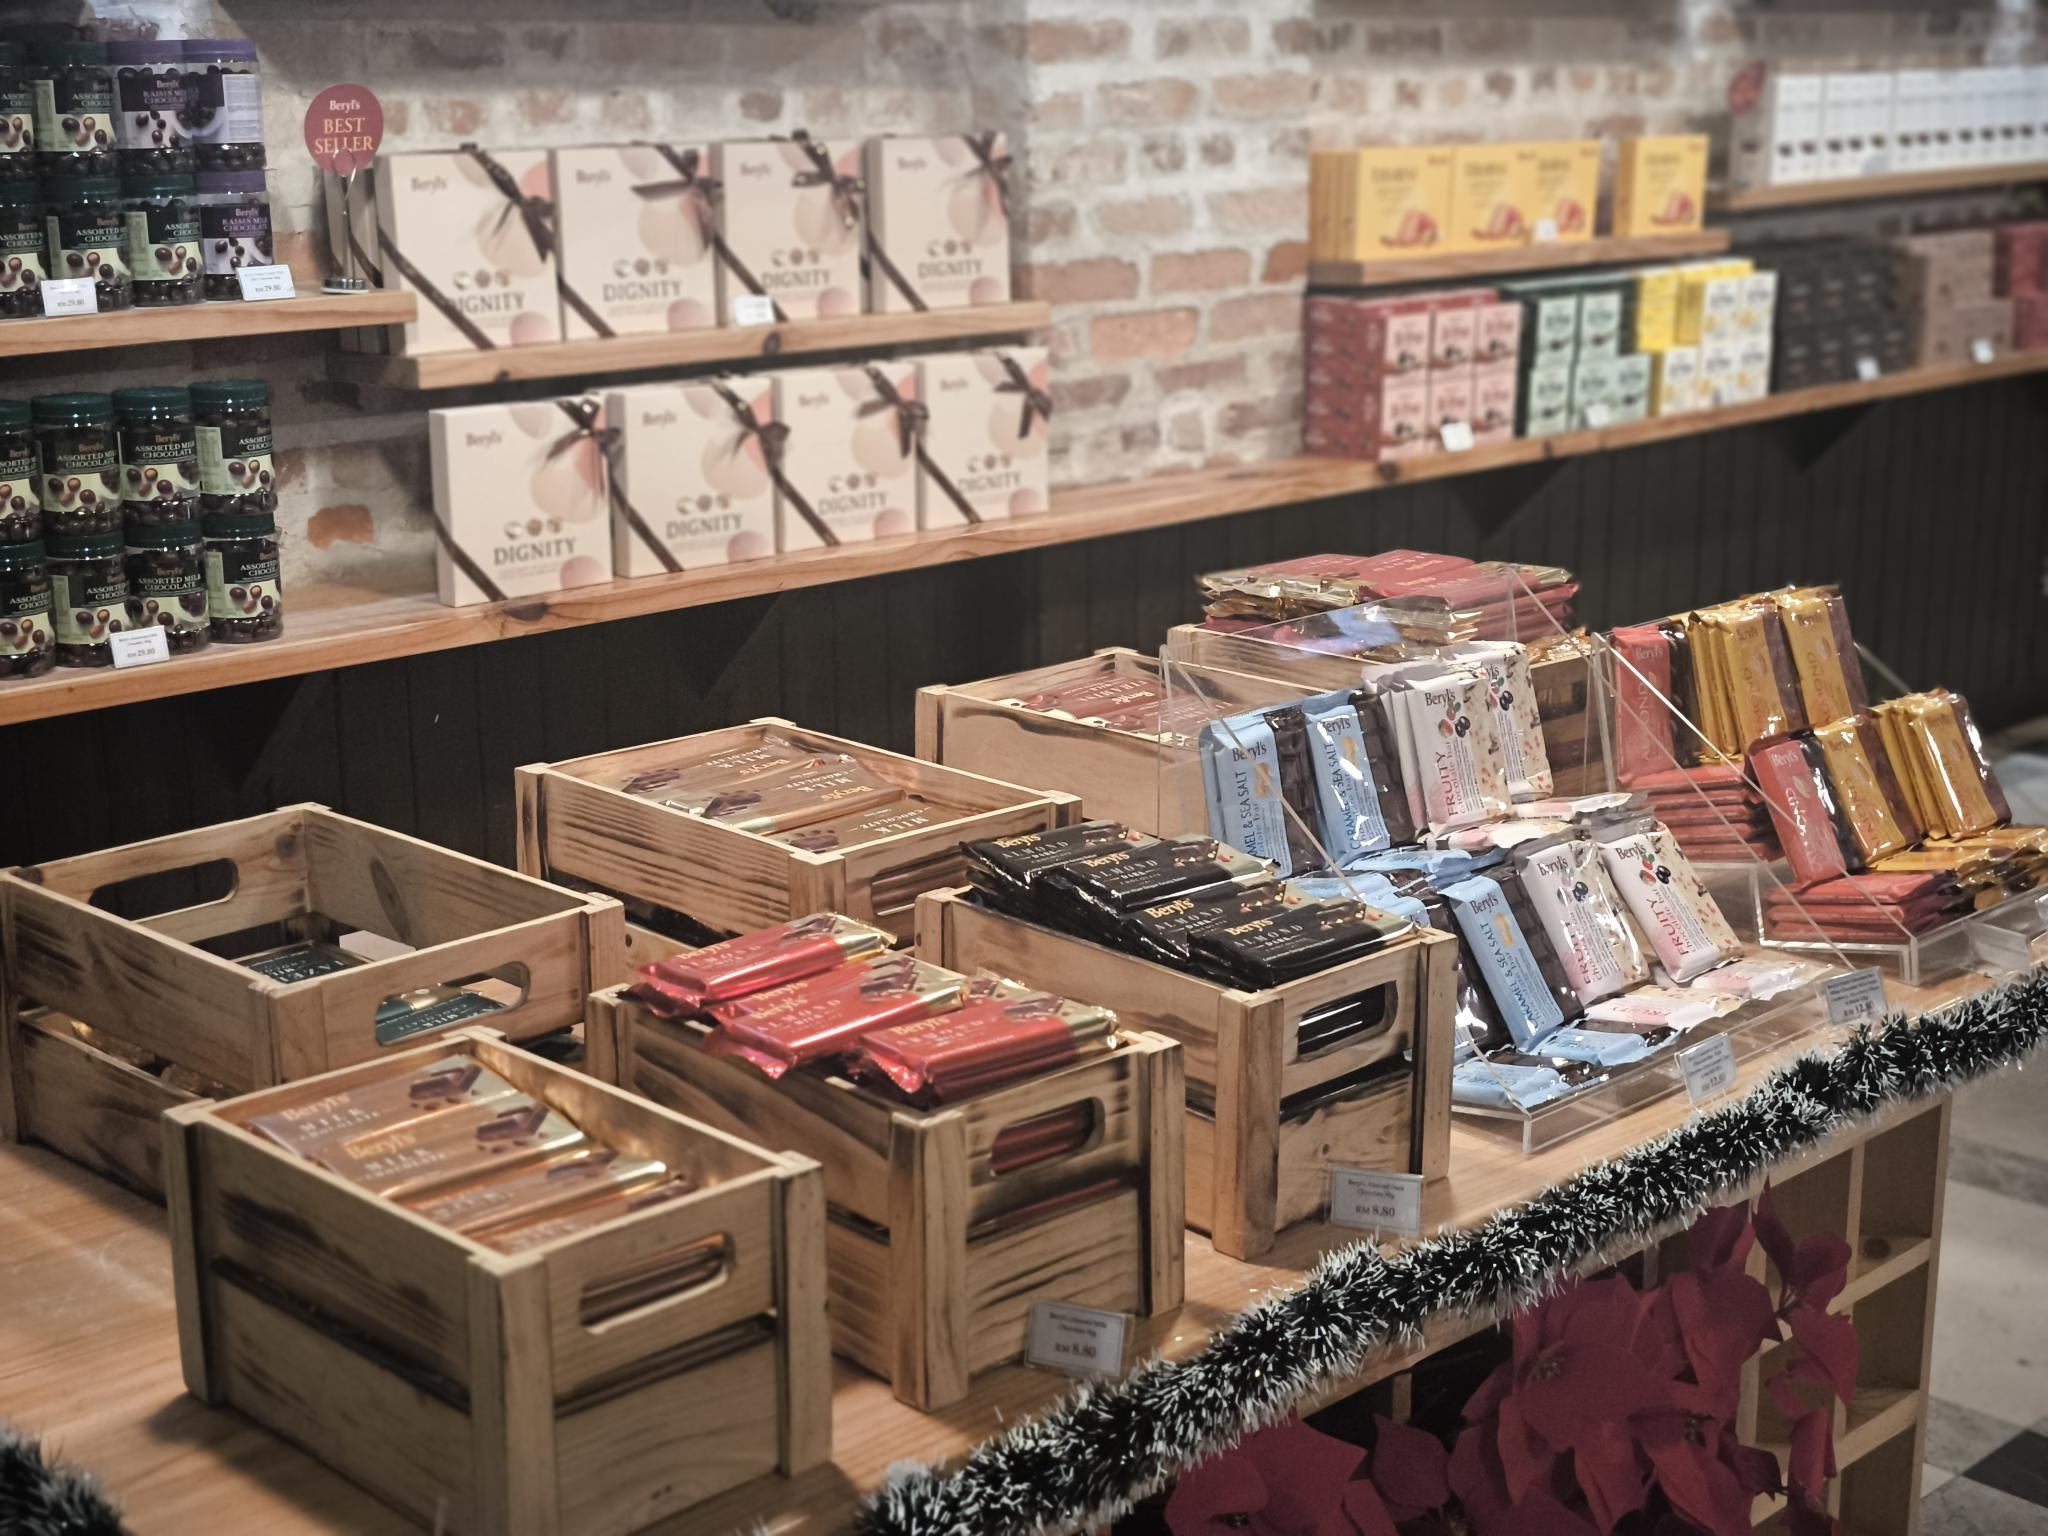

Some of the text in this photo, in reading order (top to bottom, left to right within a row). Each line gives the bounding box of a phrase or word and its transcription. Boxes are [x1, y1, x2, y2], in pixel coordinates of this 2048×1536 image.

[330, 99, 361, 113] Beryl's
[323, 117, 366, 134] BEST
[314, 135, 374, 155] SELLER
[411, 175, 447, 194] Beryl's
[575, 168, 611, 186] Beryl's
[917, 259, 983, 279] DIGNITY
[760, 269, 832, 290] DIGNITY
[602, 280, 682, 302] DIGNITY
[465, 430, 502, 449] Beryl's
[957, 471, 1022, 494] DIGNITY
[818, 491, 888, 516] DIGNITY
[665, 513, 744, 540] DIGNITY
[493, 537, 578, 567] DIGNITY
[144, 581, 197, 591] CHOCOLATE
[1424, 688, 1456, 707] Beryl's
[718, 753, 771, 768] MILK
[1323, 743, 1340, 768] SALT
[739, 758, 791, 775] Beryl's
[786, 771, 849, 788] CHOCOLATE
[797, 778, 855, 793] MILK
[1436, 751, 1459, 816] FRUITY
[820, 785, 875, 800] Beryl's
[1234, 770, 1254, 830] & SEA SALT
[860, 809, 924, 829] CHOCOLATE
[873, 817, 930, 833] MILK
[992, 835, 1041, 848] Beryl's
[1002, 841, 1069, 858] ALMOND
[1616, 842, 1647, 860] Beryl's
[1081, 853, 1130, 868] Beryl's
[1090, 860, 1158, 879] ALMOND
[1120, 871, 1146, 880] DARK
[1143, 898, 1195, 919] Beryl's
[1470, 892, 1499, 914] Beryl's
[1154, 907, 1223, 929] ALMOND
[1223, 919, 1274, 936] Beryl's
[1646, 898, 1689, 956] FRUITY
[1233, 924, 1304, 947] ALMOND
[1480, 922, 1497, 947] SALT
[1494, 948, 1509, 968] SEA
[1504, 969, 1513, 978] &
[757, 1000, 840, 1030] ALMOND
[889, 1018, 950, 1035] Beryl's
[280, 1093, 350, 1121] Beryl's
[299, 1107, 366, 1132] MILK
[345, 1131, 416, 1160] Beryl's
[365, 1148, 431, 1171] MILK
[1355, 1205, 1395, 1217] RM 8.80
